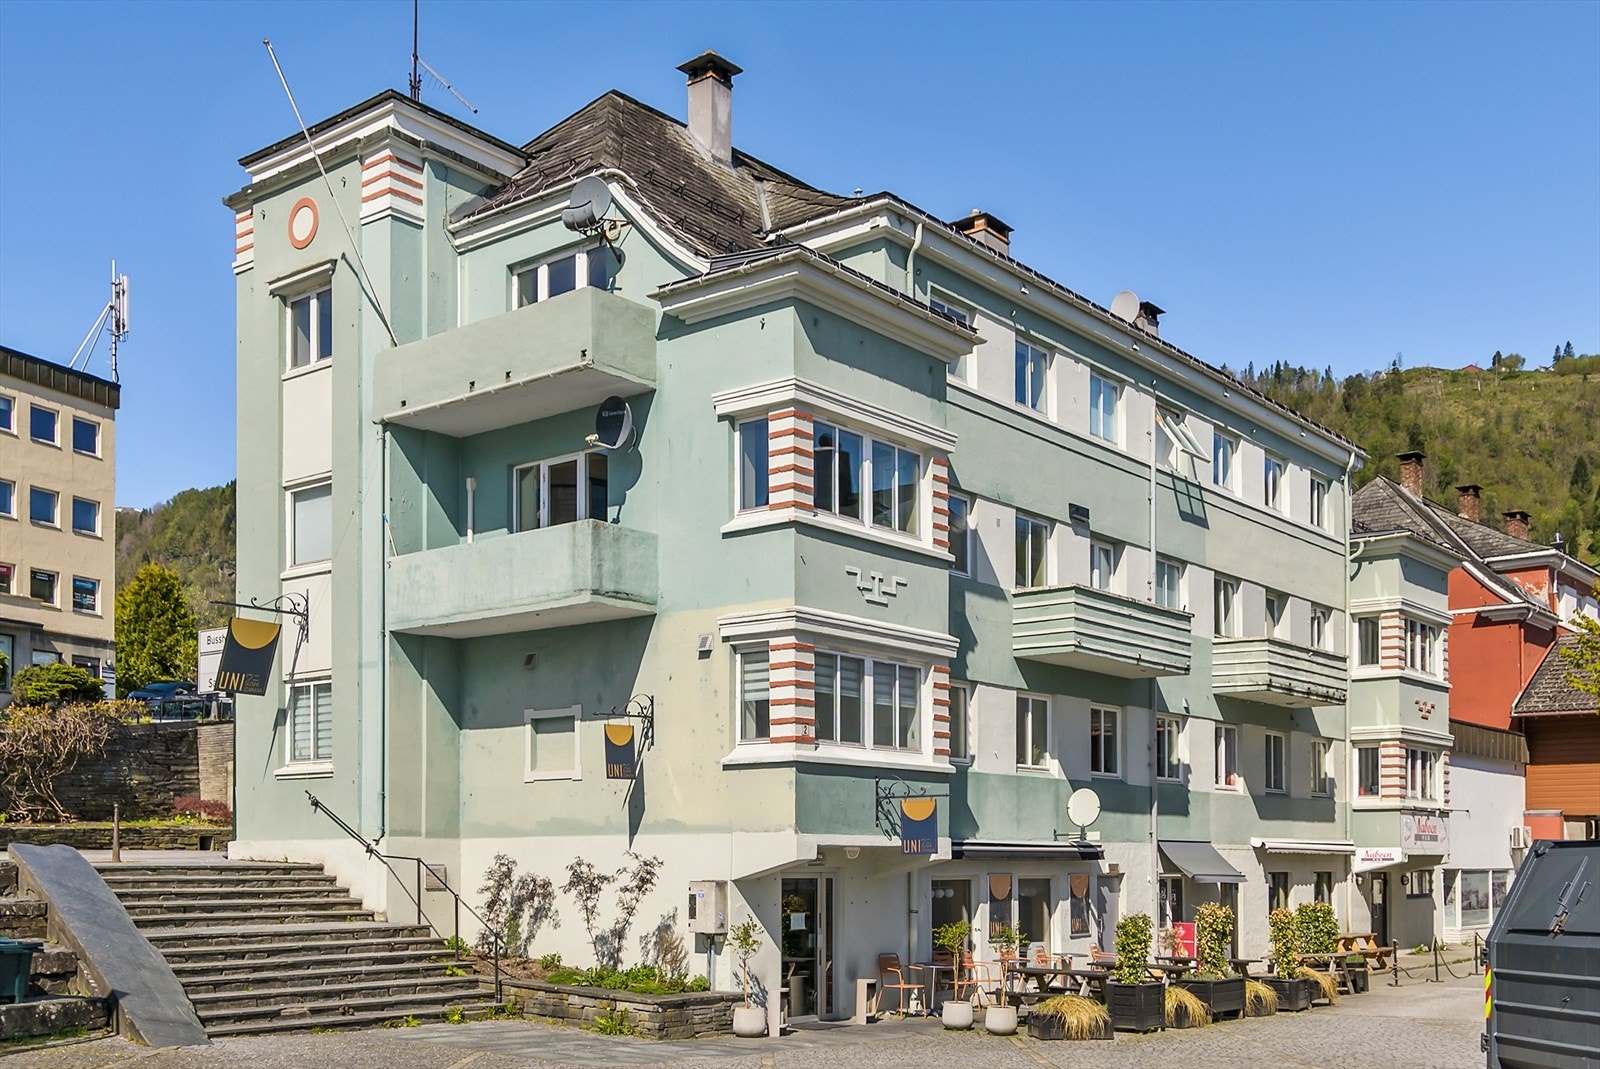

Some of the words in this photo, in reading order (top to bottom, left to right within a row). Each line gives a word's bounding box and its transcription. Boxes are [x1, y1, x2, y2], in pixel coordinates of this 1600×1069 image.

[219, 671, 245, 691] UNI
[607, 763, 623, 777] UNI
[903, 839, 921, 853] UNI
